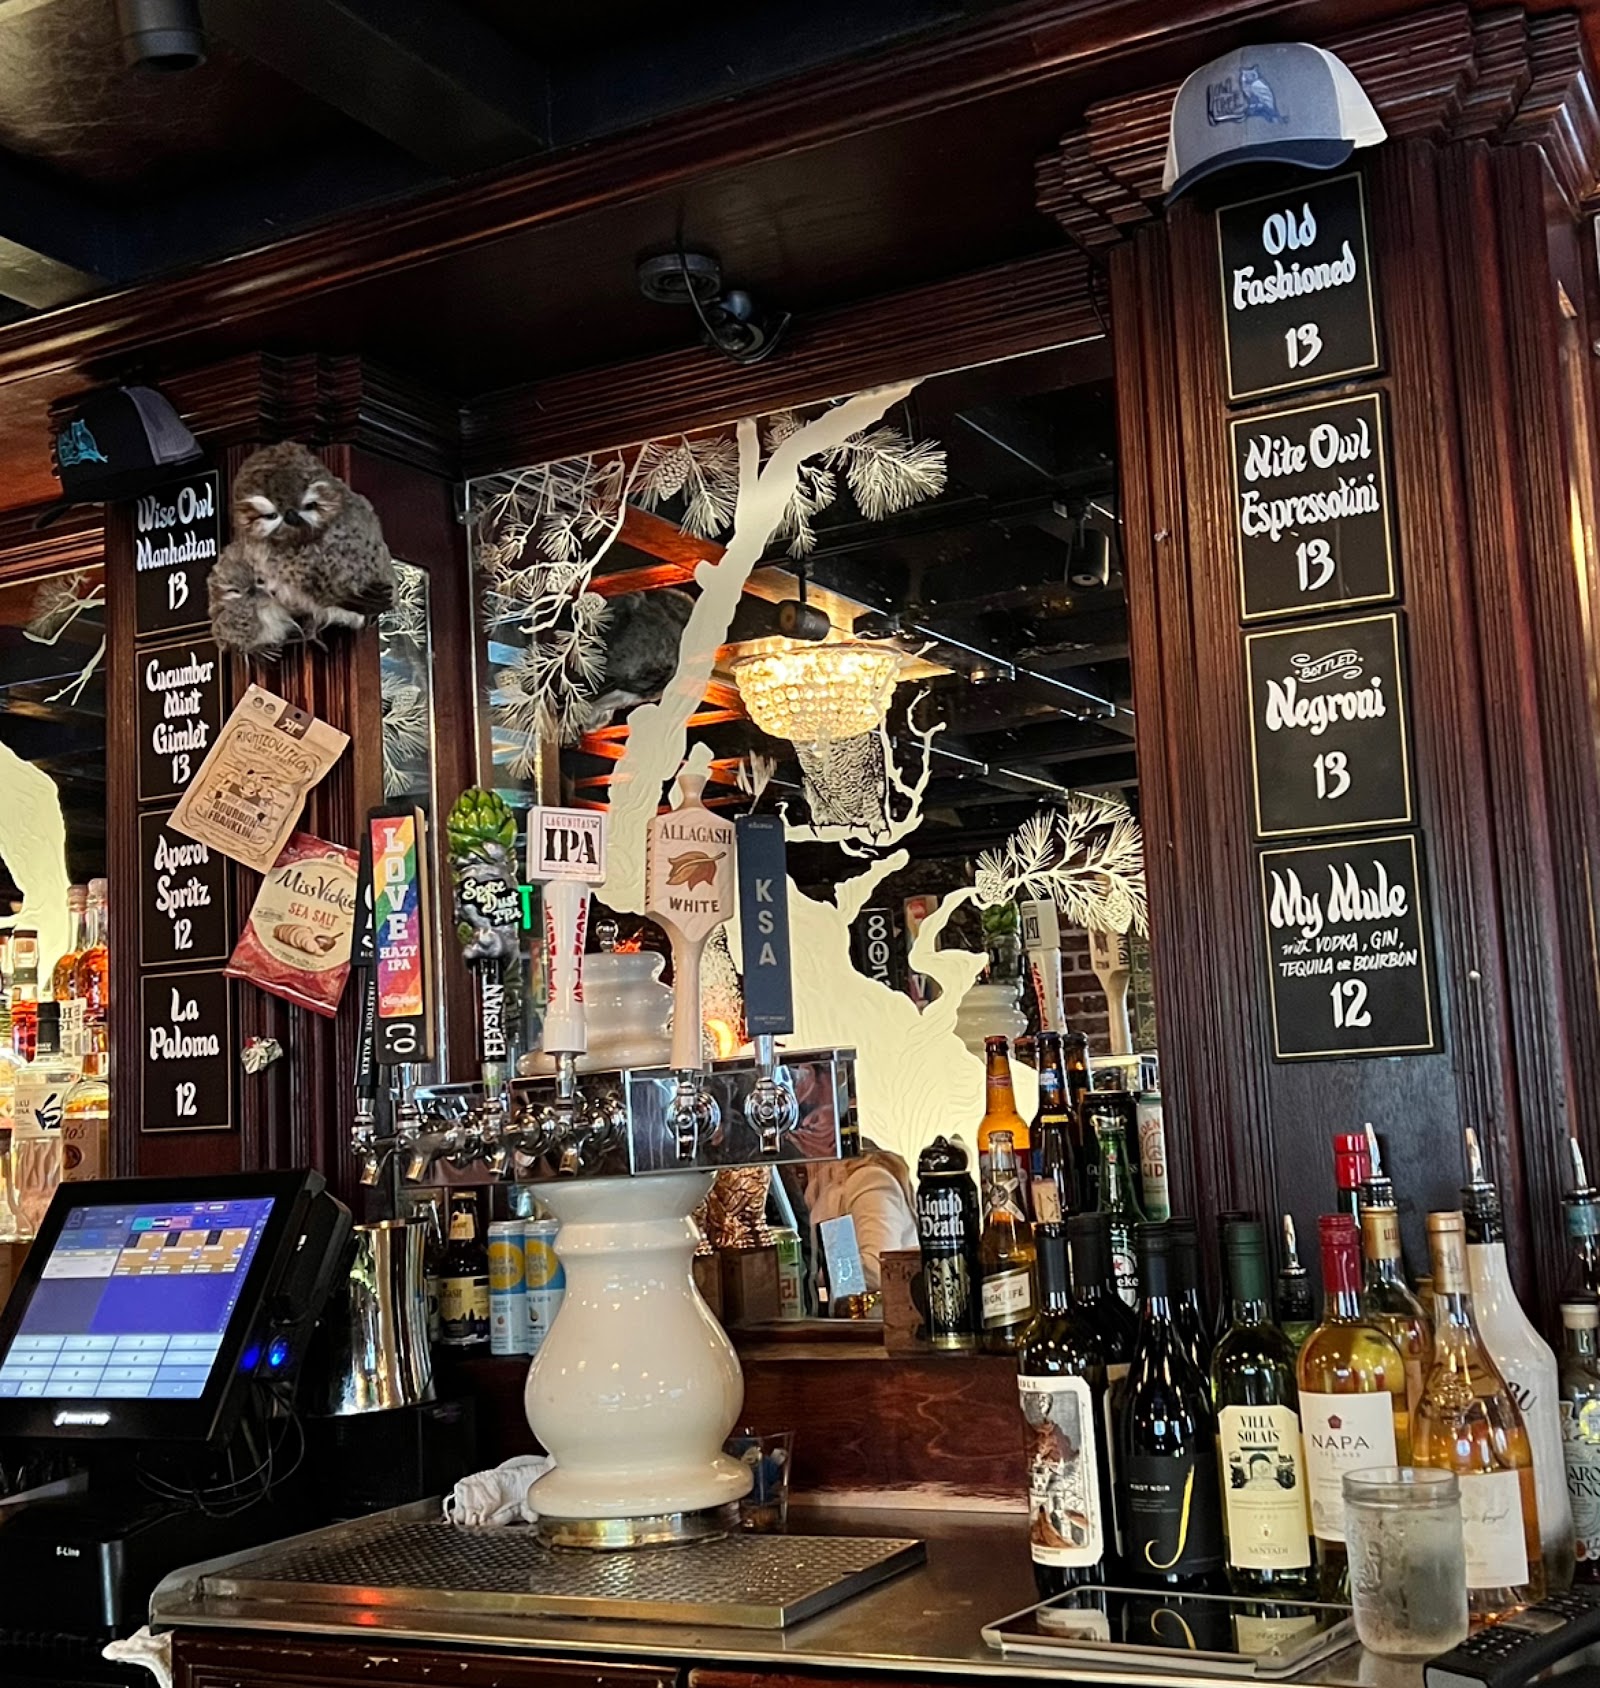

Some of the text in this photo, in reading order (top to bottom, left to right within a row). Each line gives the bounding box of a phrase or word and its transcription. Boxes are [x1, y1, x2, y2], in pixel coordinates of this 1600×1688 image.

[1262, 202, 1317, 256] Old
[1232, 240, 1357, 311] Fashioned
[1284, 322, 1323, 369] 13
[1243, 417, 1372, 482] Nite Owl
[137, 481, 214, 533] Wise Owl
[1241, 473, 1380, 542] Espressotini
[136, 529, 217, 572] Manhattan
[1295, 538, 1336, 592] 13
[167, 570, 190, 611] 13
[145, 651, 214, 693] Cucumber
[1300, 653, 1358, 680] BOTTLED
[163, 688, 202, 719] Mint
[1265, 676, 1387, 736] Negroni
[152, 718, 210, 755] Gimlet
[171, 753, 191, 785] 13
[1313, 750, 1352, 800] 13
[207, 809, 252, 839] FRANKLIN
[211, 799, 260, 829] BOURBON
[545, 815, 590, 829] LAGUNITAS
[544, 827, 598, 865] IPA
[660, 822, 732, 845] ALLAGASH
[155, 874, 211, 920] Spritz
[275, 868, 316, 897] Miss
[382, 827, 410, 942] LOVE
[461, 878, 507, 904] Space
[1269, 859, 1409, 939] My Mule
[288, 902, 308, 921] SEA
[311, 911, 340, 929] SALT
[482, 890, 520, 915] Dust
[669, 896, 721, 913] WHITE
[173, 918, 194, 951] 12
[380, 944, 418, 961] HAZY
[387, 958, 412, 972] IPA
[1279, 953, 1333, 978] TEQUILA
[1353, 948, 1418, 974] BOURBON
[170, 987, 199, 1023] La
[482, 984, 507, 1057] ELYSIAN
[1329, 977, 1372, 1030] 12
[150, 1025, 220, 1061] Paloma
[175, 1081, 198, 1118] 12
[918, 1187, 963, 1221] Liquid
[921, 1213, 965, 1237] Death
[1237, 1430, 1280, 1444] SOLAIS
[1240, 1415, 1275, 1429] VILLA
[1311, 1433, 1370, 1450] NAPA
[1149, 1484, 1171, 1492] NOIR
